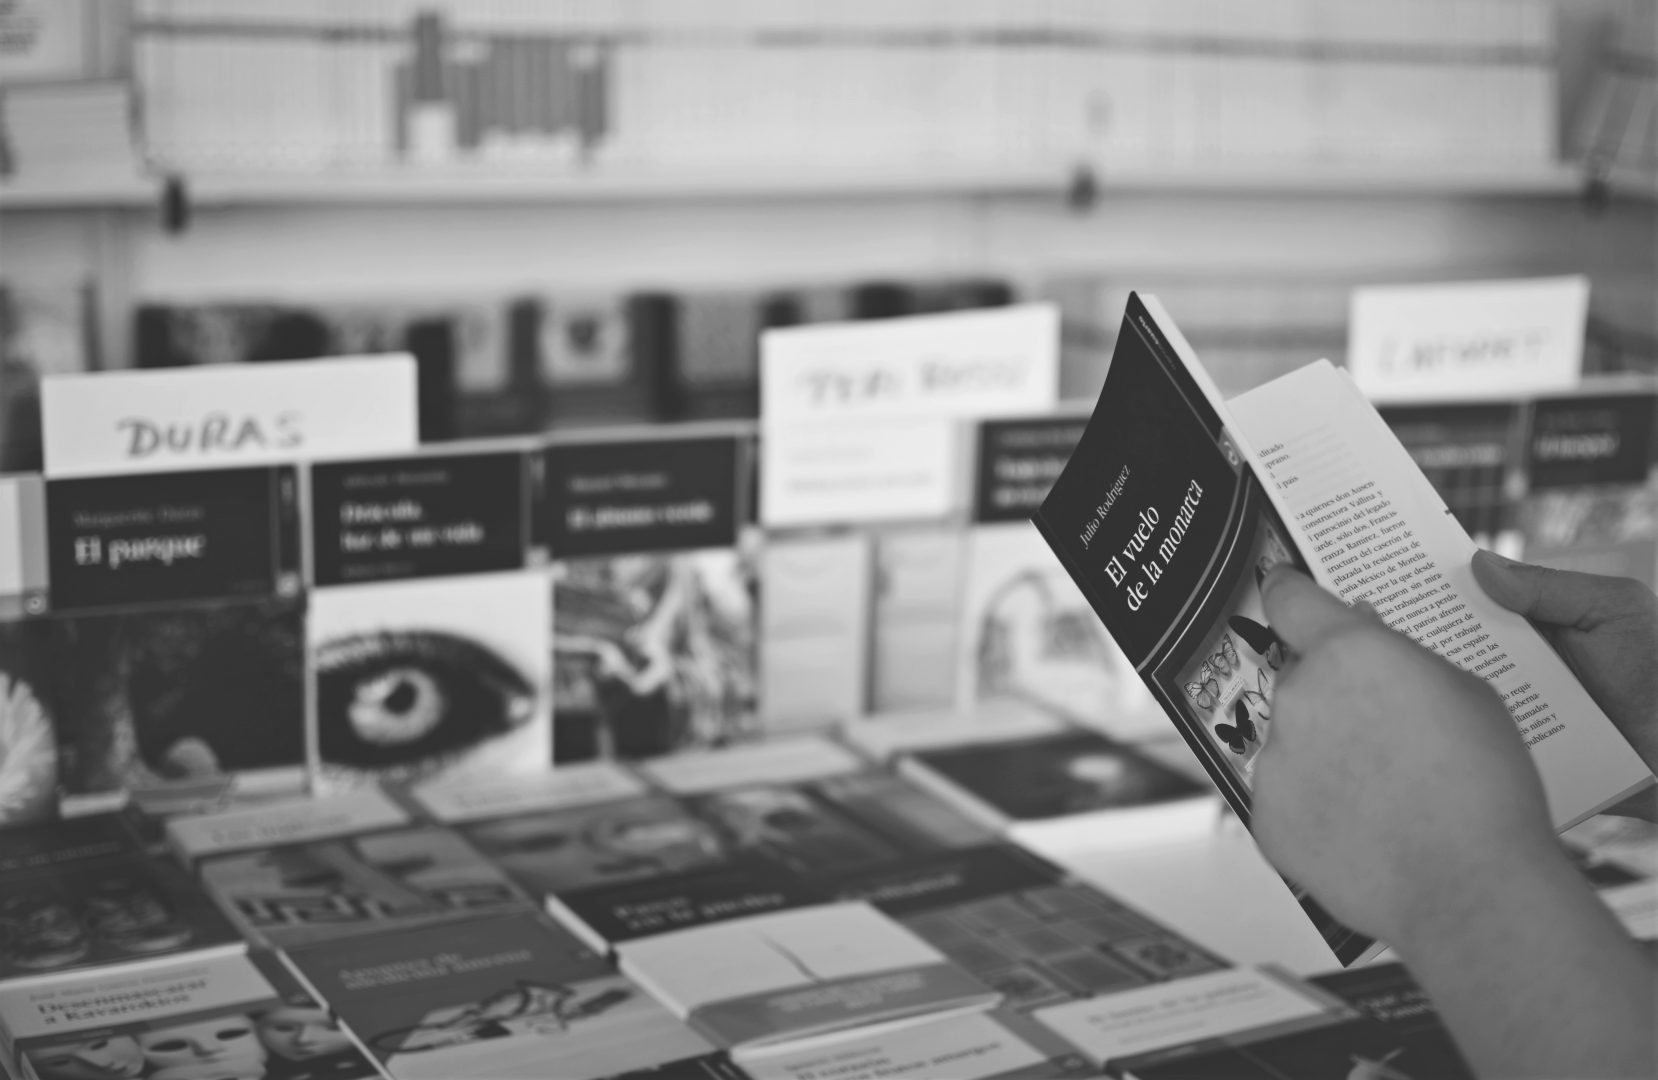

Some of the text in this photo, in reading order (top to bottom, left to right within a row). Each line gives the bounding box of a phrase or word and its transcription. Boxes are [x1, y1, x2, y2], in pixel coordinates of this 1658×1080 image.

[114, 411, 306, 459] DURAS
[1264, 453, 1289, 469] prano.
[1080, 464, 1131, 550] Julio Rodríguez
[75, 535, 206, 569] El parque
[1104, 506, 1160, 588] El vuelo
[1127, 479, 1203, 612] de la monarca
[1327, 555, 1359, 574] tructura
[1372, 586, 1409, 607] ntregaron
[1482, 662, 1516, 681] cupados
